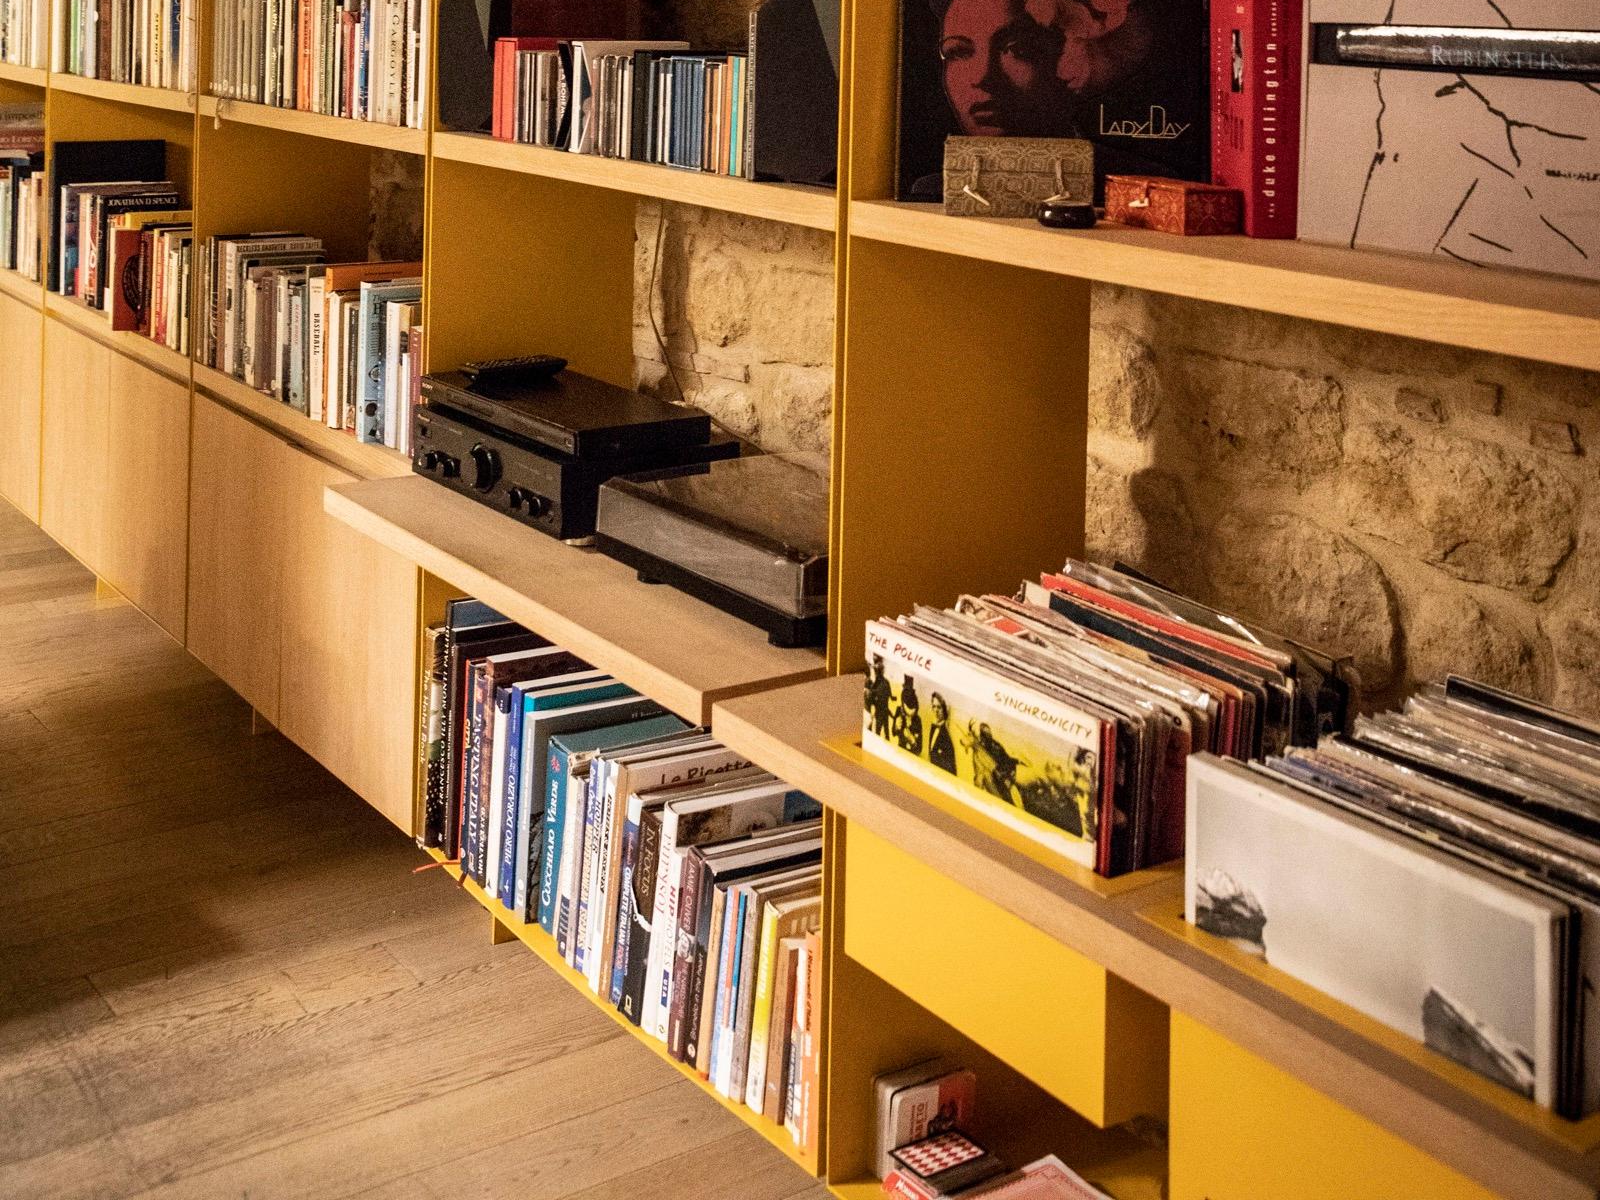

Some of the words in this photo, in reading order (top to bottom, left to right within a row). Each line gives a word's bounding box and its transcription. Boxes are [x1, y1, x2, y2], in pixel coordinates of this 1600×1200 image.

[388, 15, 401, 97] GARGOYLE
[1431, 45, 1565, 70] RUBINSTEIN
[1263, 42, 1280, 146] ellington
[1263, 155, 1276, 198] duke
[108, 198, 144, 207] JONATHAN
[152, 197, 177, 205] SPENCE
[313, 313, 321, 356] BASEBALL
[868, 632, 888, 652] THE
[892, 643, 933, 671] POLICE
[423, 669, 431, 691] The
[421, 695, 430, 728] Hotel
[993, 690, 1093, 739] SYNCHRONICITY
[419, 733, 428, 765] Book
[440, 725, 448, 749] ILLY
[469, 713, 482, 785] TASTING
[438, 753, 447, 805] FRANCESCO
[467, 791, 480, 844] ITALY
[505, 775, 516, 828] DORAZIO
[546, 778, 560, 823] VERDE
[592, 800, 602, 854] HOPPER
[646, 825, 656, 847] IN
[503, 829, 514, 866] PIERO
[540, 828, 556, 906] CUCCHIAIO
[619, 866, 632, 913] COMPLETE
[641, 847, 654, 897] FOCUS
[688, 854, 700, 893] JAMIE
[668, 886, 677, 917] HIP
[682, 895, 695, 934] OLIVER
[618, 912, 628, 945] ITALIAN
[615, 944, 625, 970] FOOD
[661, 979, 669, 1003] USA
